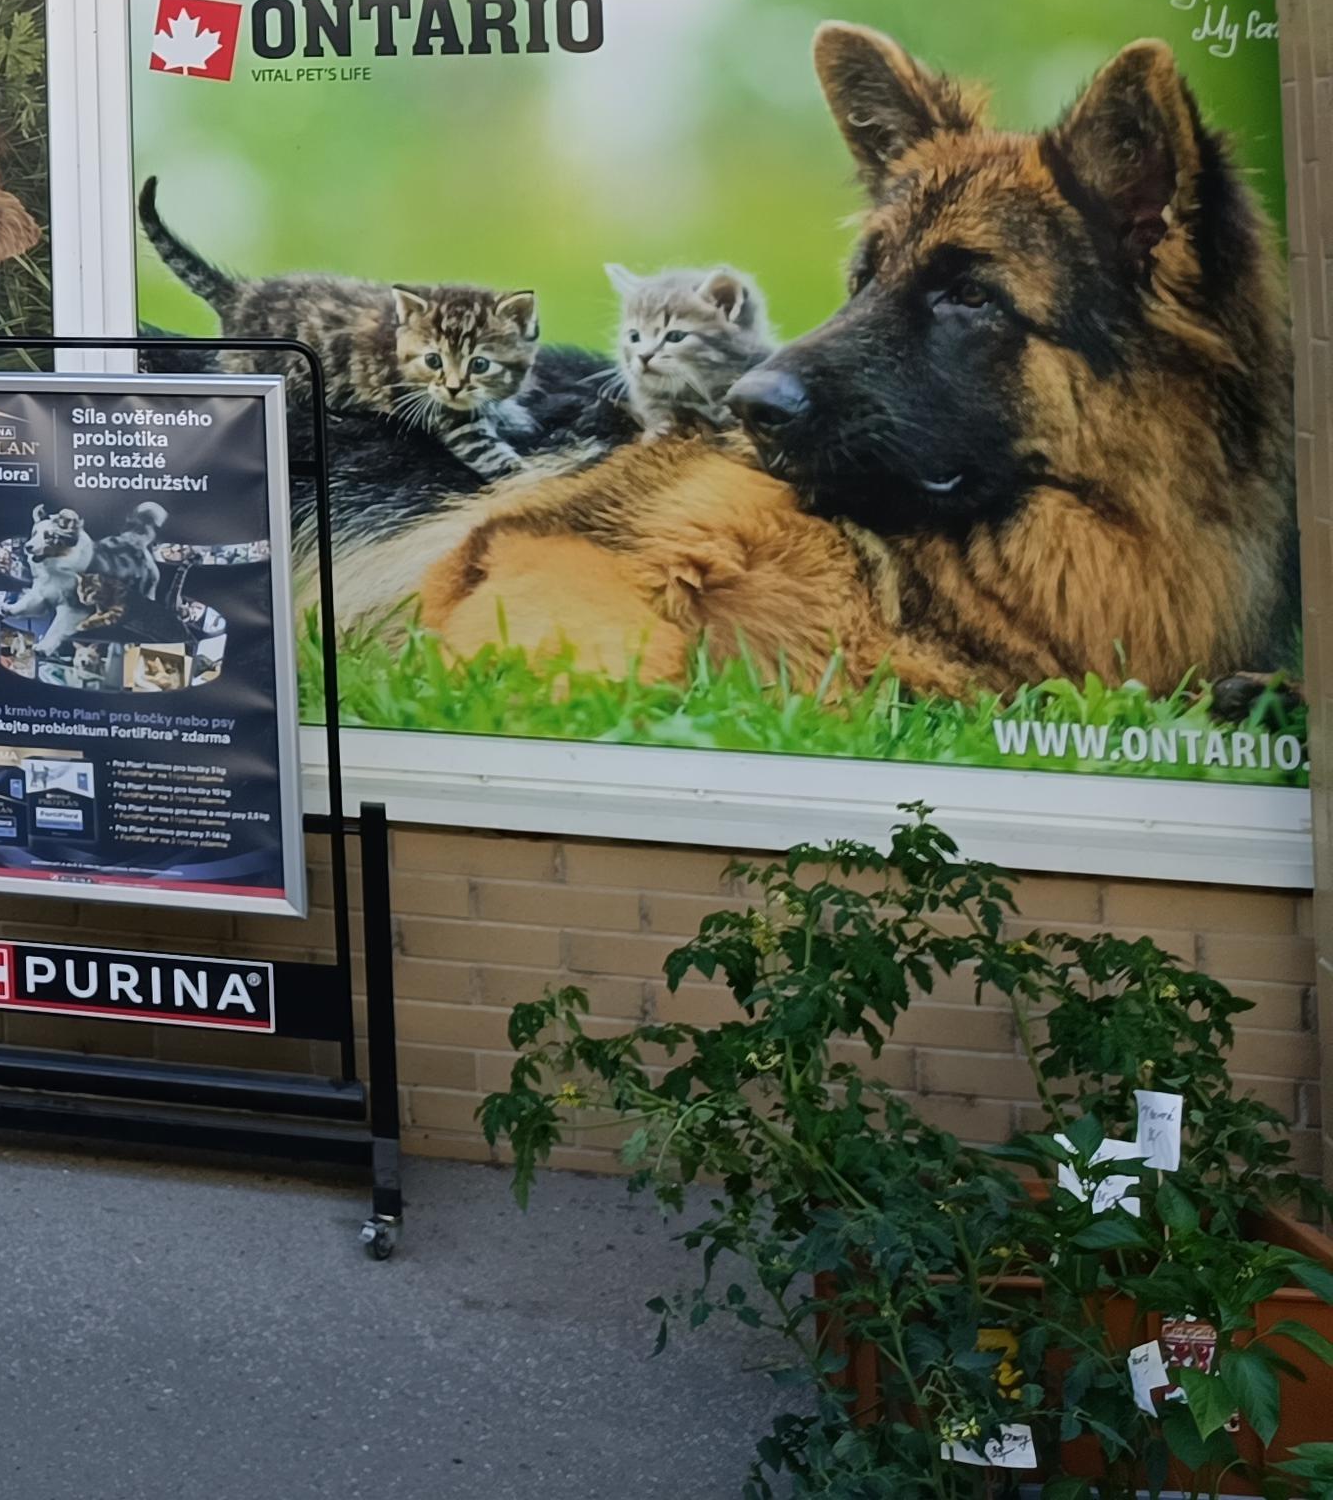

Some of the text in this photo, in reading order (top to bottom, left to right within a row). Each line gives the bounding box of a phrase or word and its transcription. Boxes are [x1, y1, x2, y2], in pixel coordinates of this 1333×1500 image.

[1191, 4, 1279, 59] My fa
[251, 68, 293, 82] VITAL
[341, 67, 371, 81] LIFE
[71, 408, 213, 427] Síla ověřeného
[73, 430, 169, 449] probiotika
[73, 451, 166, 470] pro každé
[73, 472, 209, 492] dobrodružství
[5, 704, 47, 718] krmivo
[49, 707, 71, 719] Pro
[109, 712, 131, 724] pro
[133, 712, 173, 728] kočky
[175, 715, 209, 727] nebo
[211, 718, 235, 731] psy
[32, 721, 109, 738] probiotikum
[181, 729, 231, 745] zdarma
